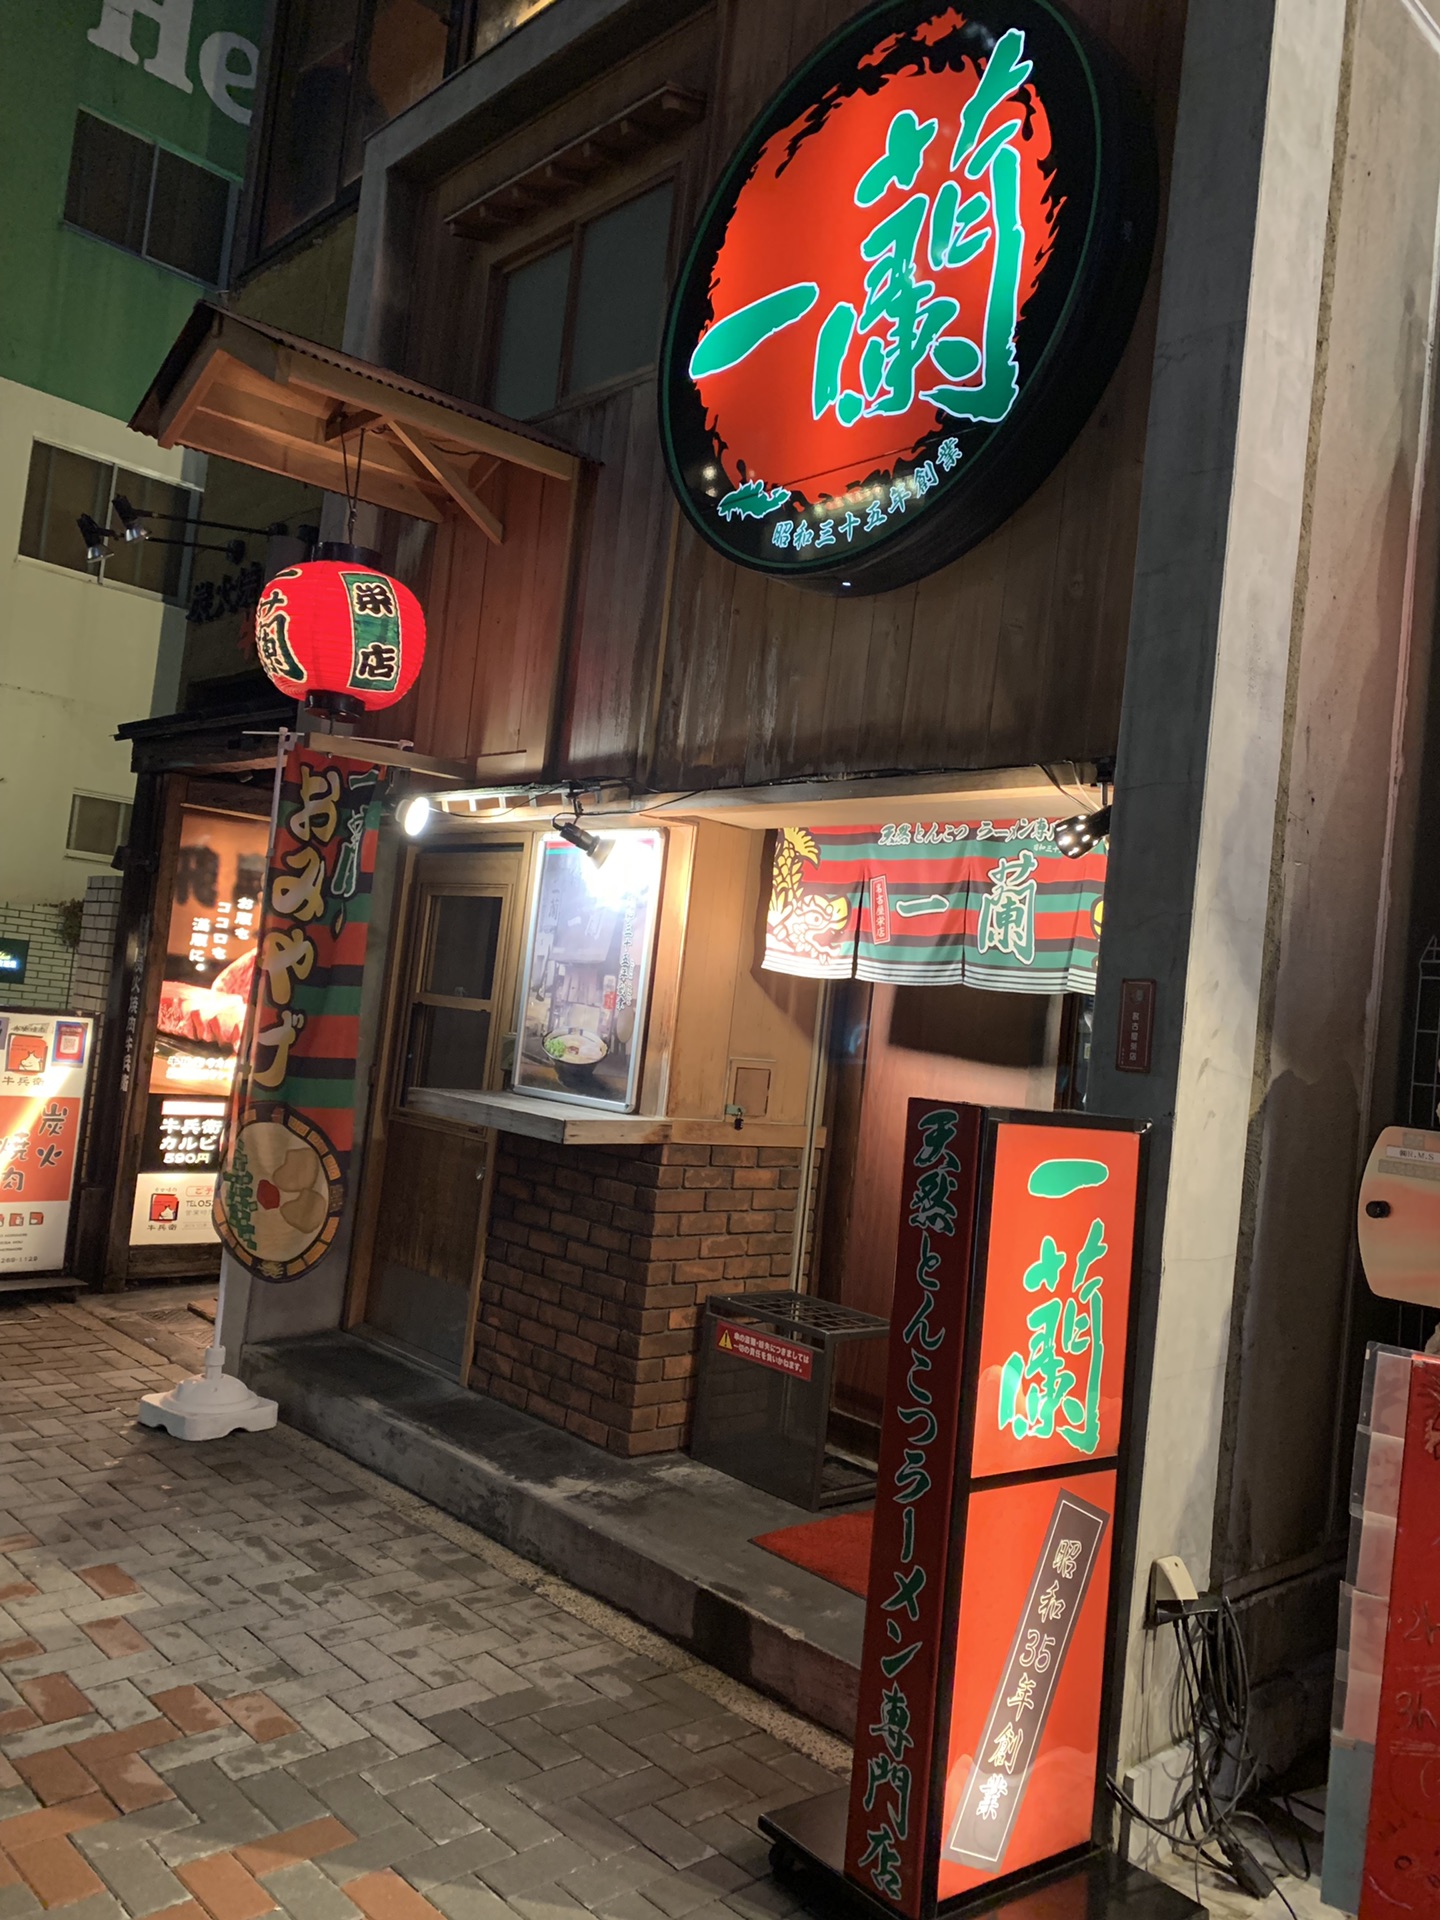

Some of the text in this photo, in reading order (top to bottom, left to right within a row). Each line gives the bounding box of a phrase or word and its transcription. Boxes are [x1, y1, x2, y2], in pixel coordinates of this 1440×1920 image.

[688, 28, 1033, 426] 一蘭
[771, 437, 963, 550] 昭和三十五年創業
[352, 582, 398, 681] 栄店
[877, 822, 970, 846] 天然とんこつ
[251, 764, 341, 1089] おみやげ
[875, 883, 887, 938] 名古屋栄店
[896, 849, 1039, 966] 一蘭
[38, 1103, 68, 1168] 炭火
[159, 1135, 217, 1151] カルビ
[998, 1158, 1110, 1455] 一蘭
[858, 1108, 962, 1899] 天然とんこつラーメン専門店
[976, 1539, 1082, 1821] 昭和35年創業
